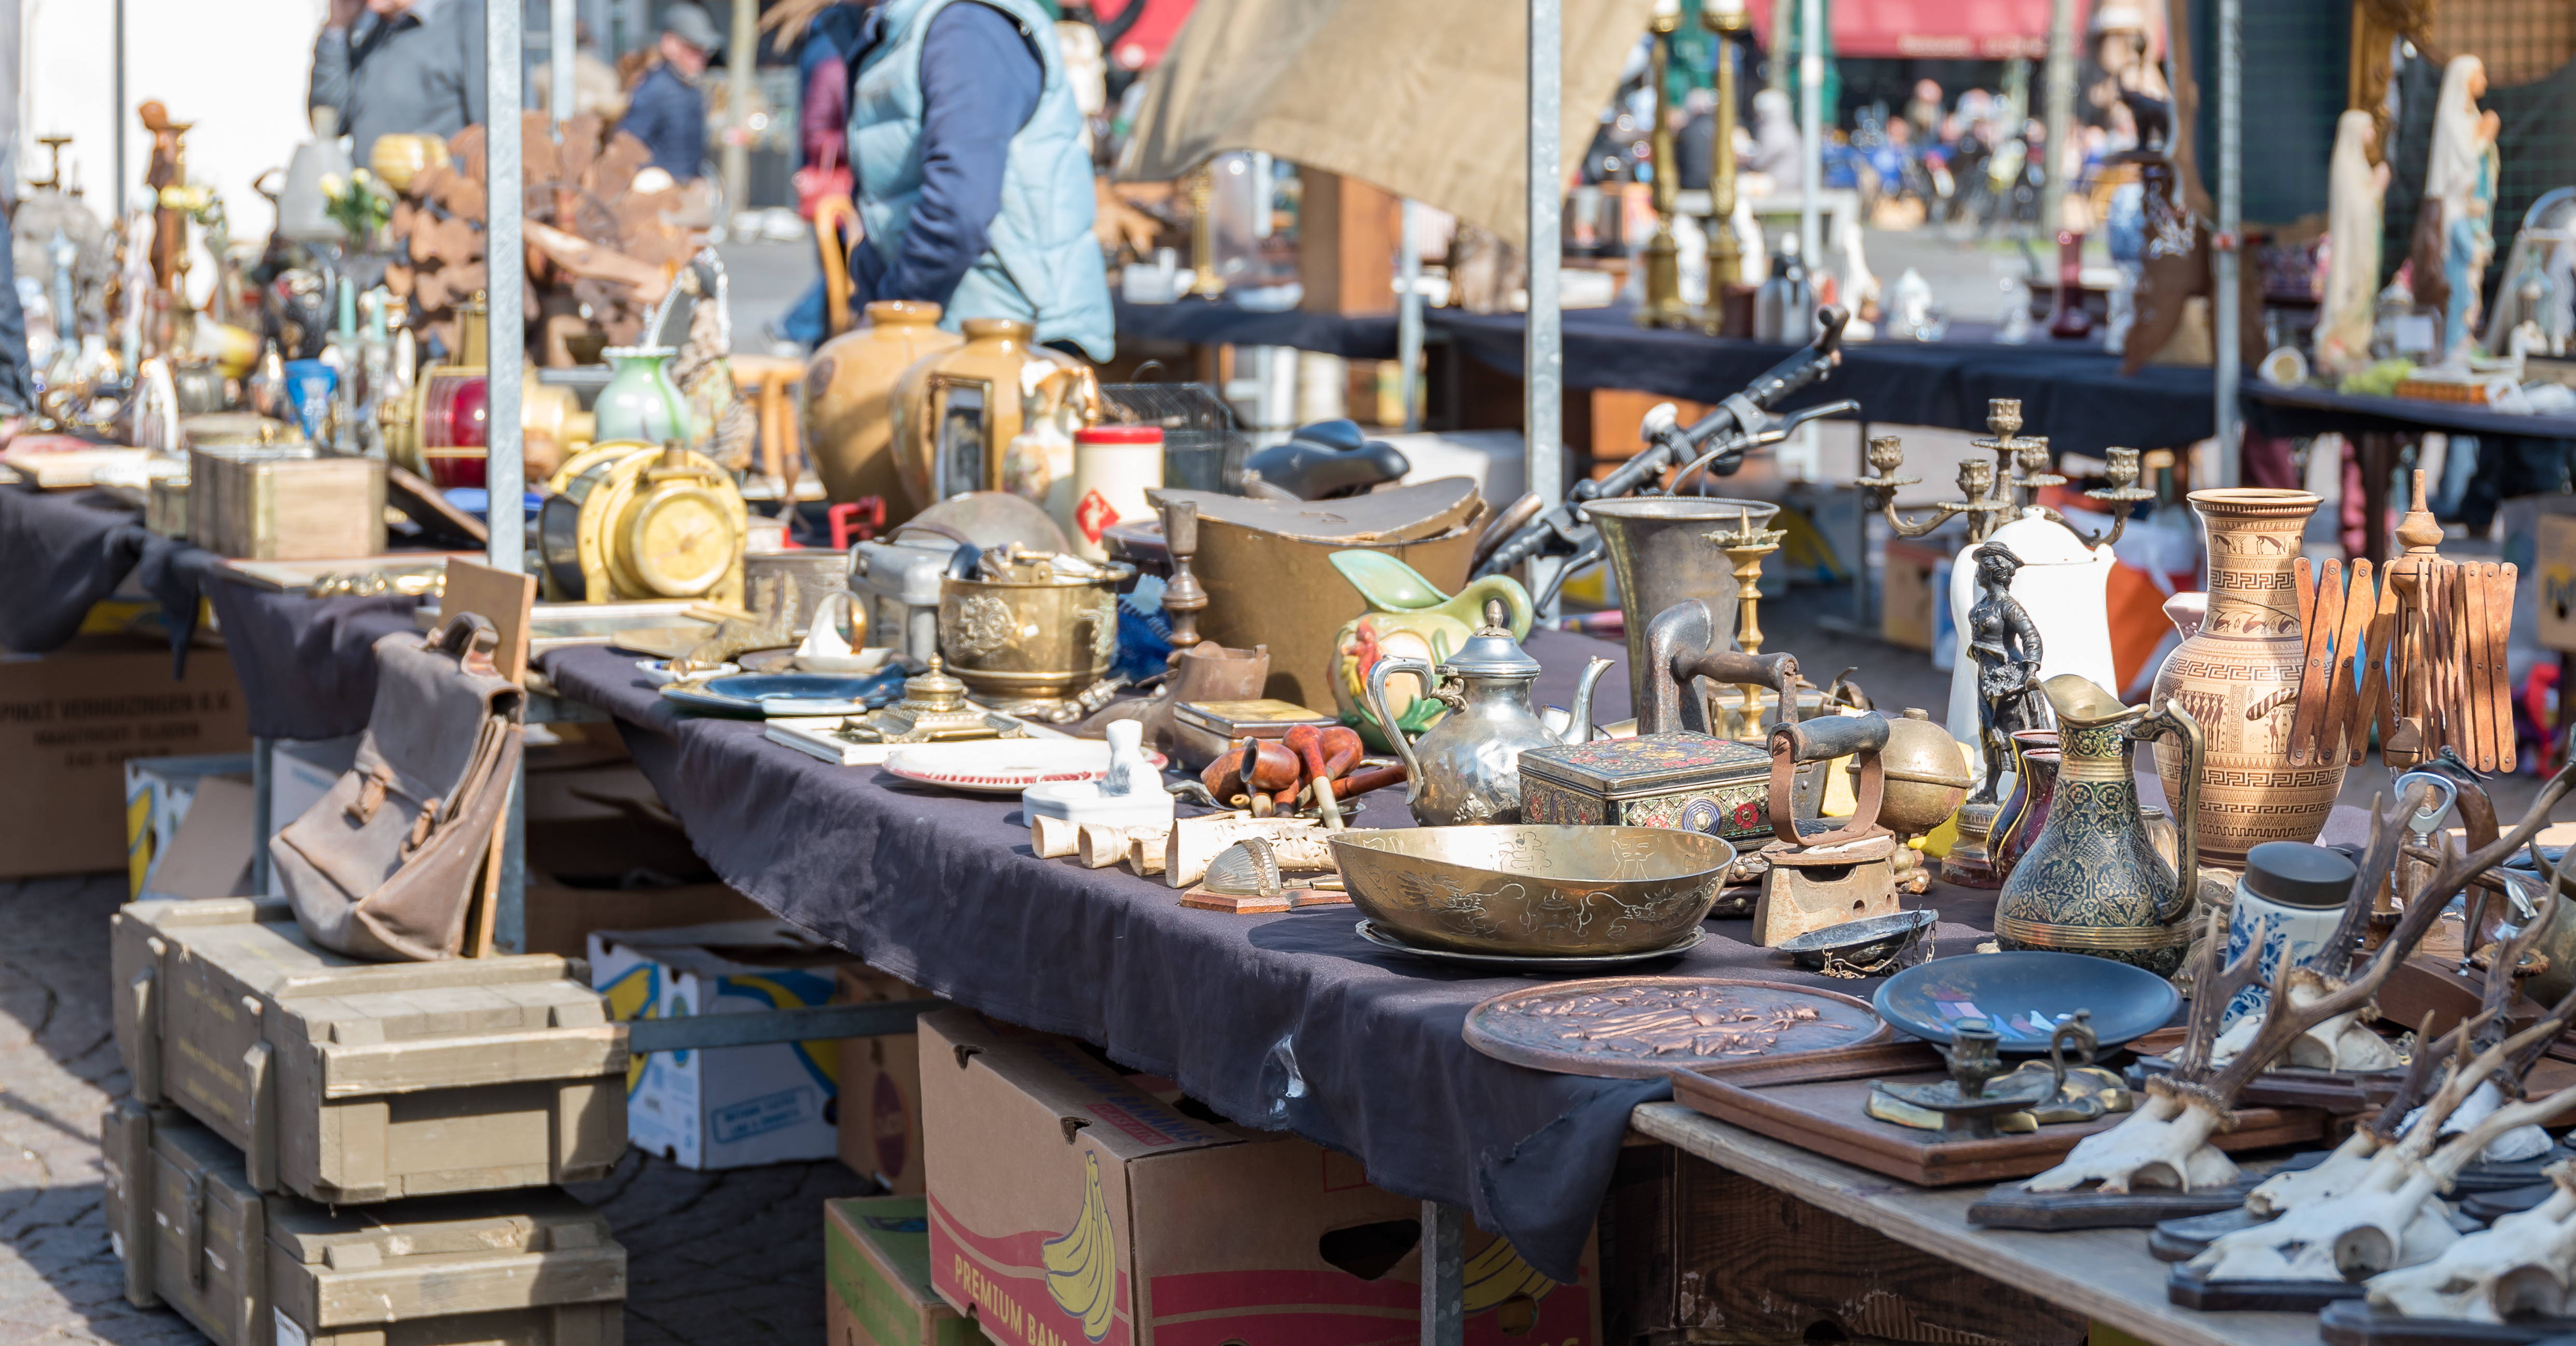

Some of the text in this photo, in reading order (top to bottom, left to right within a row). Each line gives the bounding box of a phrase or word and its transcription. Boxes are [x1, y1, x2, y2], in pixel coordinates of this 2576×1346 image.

[1092, 1104, 1167, 1144] CLASS EXTRA
[1107, 1096, 1215, 1142] BANANAS
[955, 1253, 1067, 1346] PREMIUM BAN
